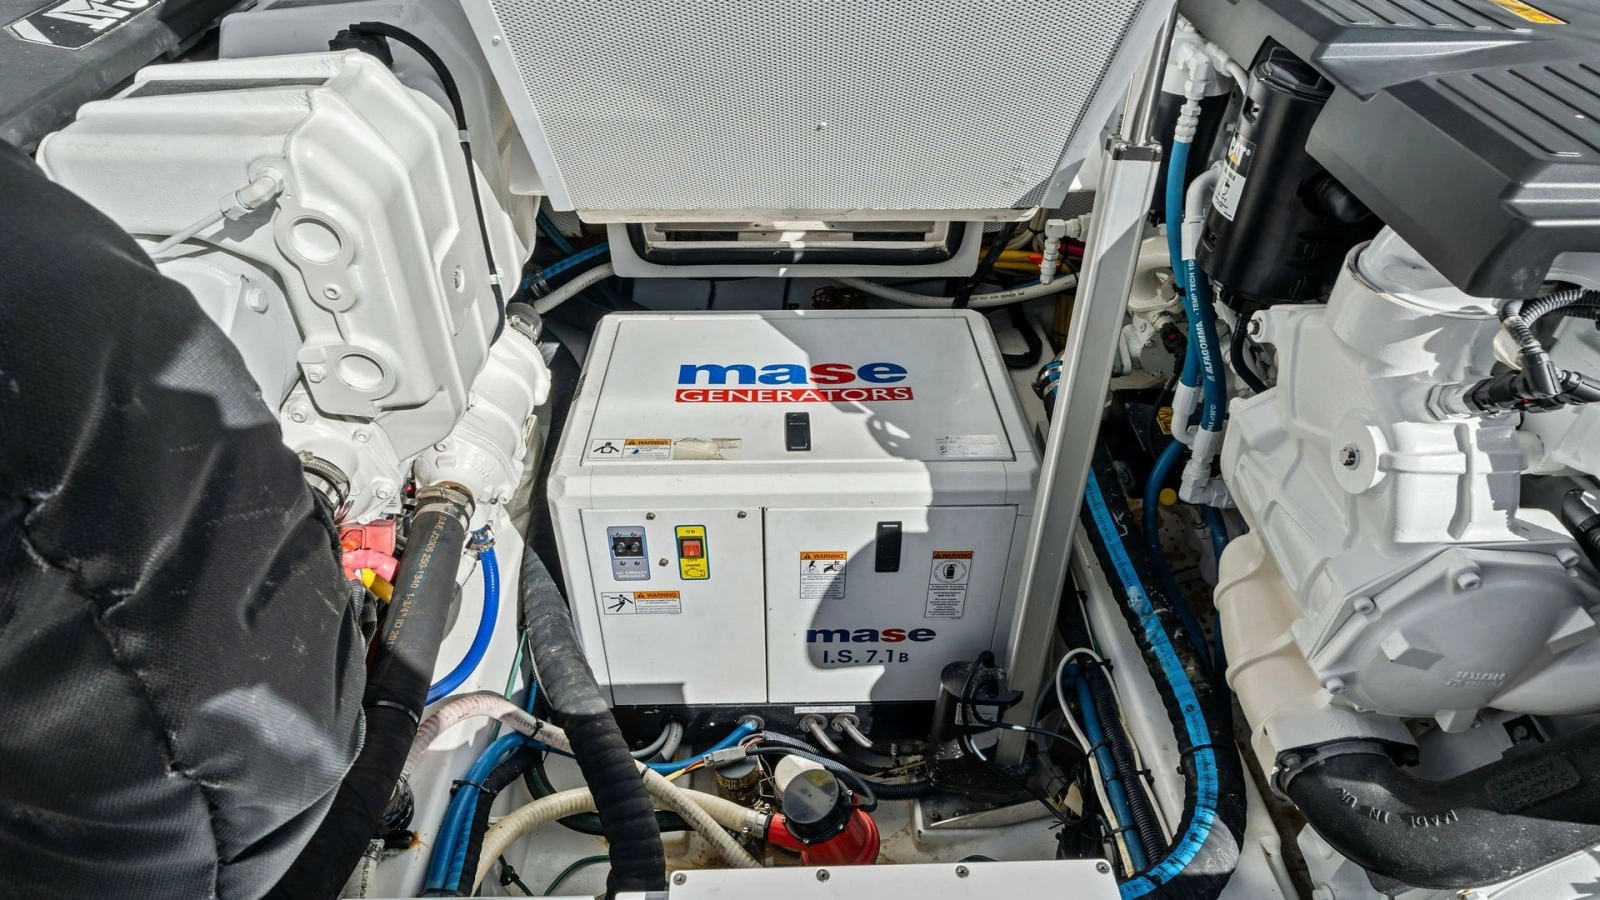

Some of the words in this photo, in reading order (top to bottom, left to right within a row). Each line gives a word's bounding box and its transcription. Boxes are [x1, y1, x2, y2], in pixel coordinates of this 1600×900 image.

[1195, 320, 1215, 376] ALFAGOMMA
[677, 362, 908, 385] mase
[679, 389, 909, 402] GENERATORS
[434, 515, 447, 531] SAE
[425, 530, 440, 553] J2006
[410, 553, 431, 589] 250-1340
[394, 618, 405, 629] ID
[806, 628, 937, 643] mase
[823, 649, 860, 664] I.S.
